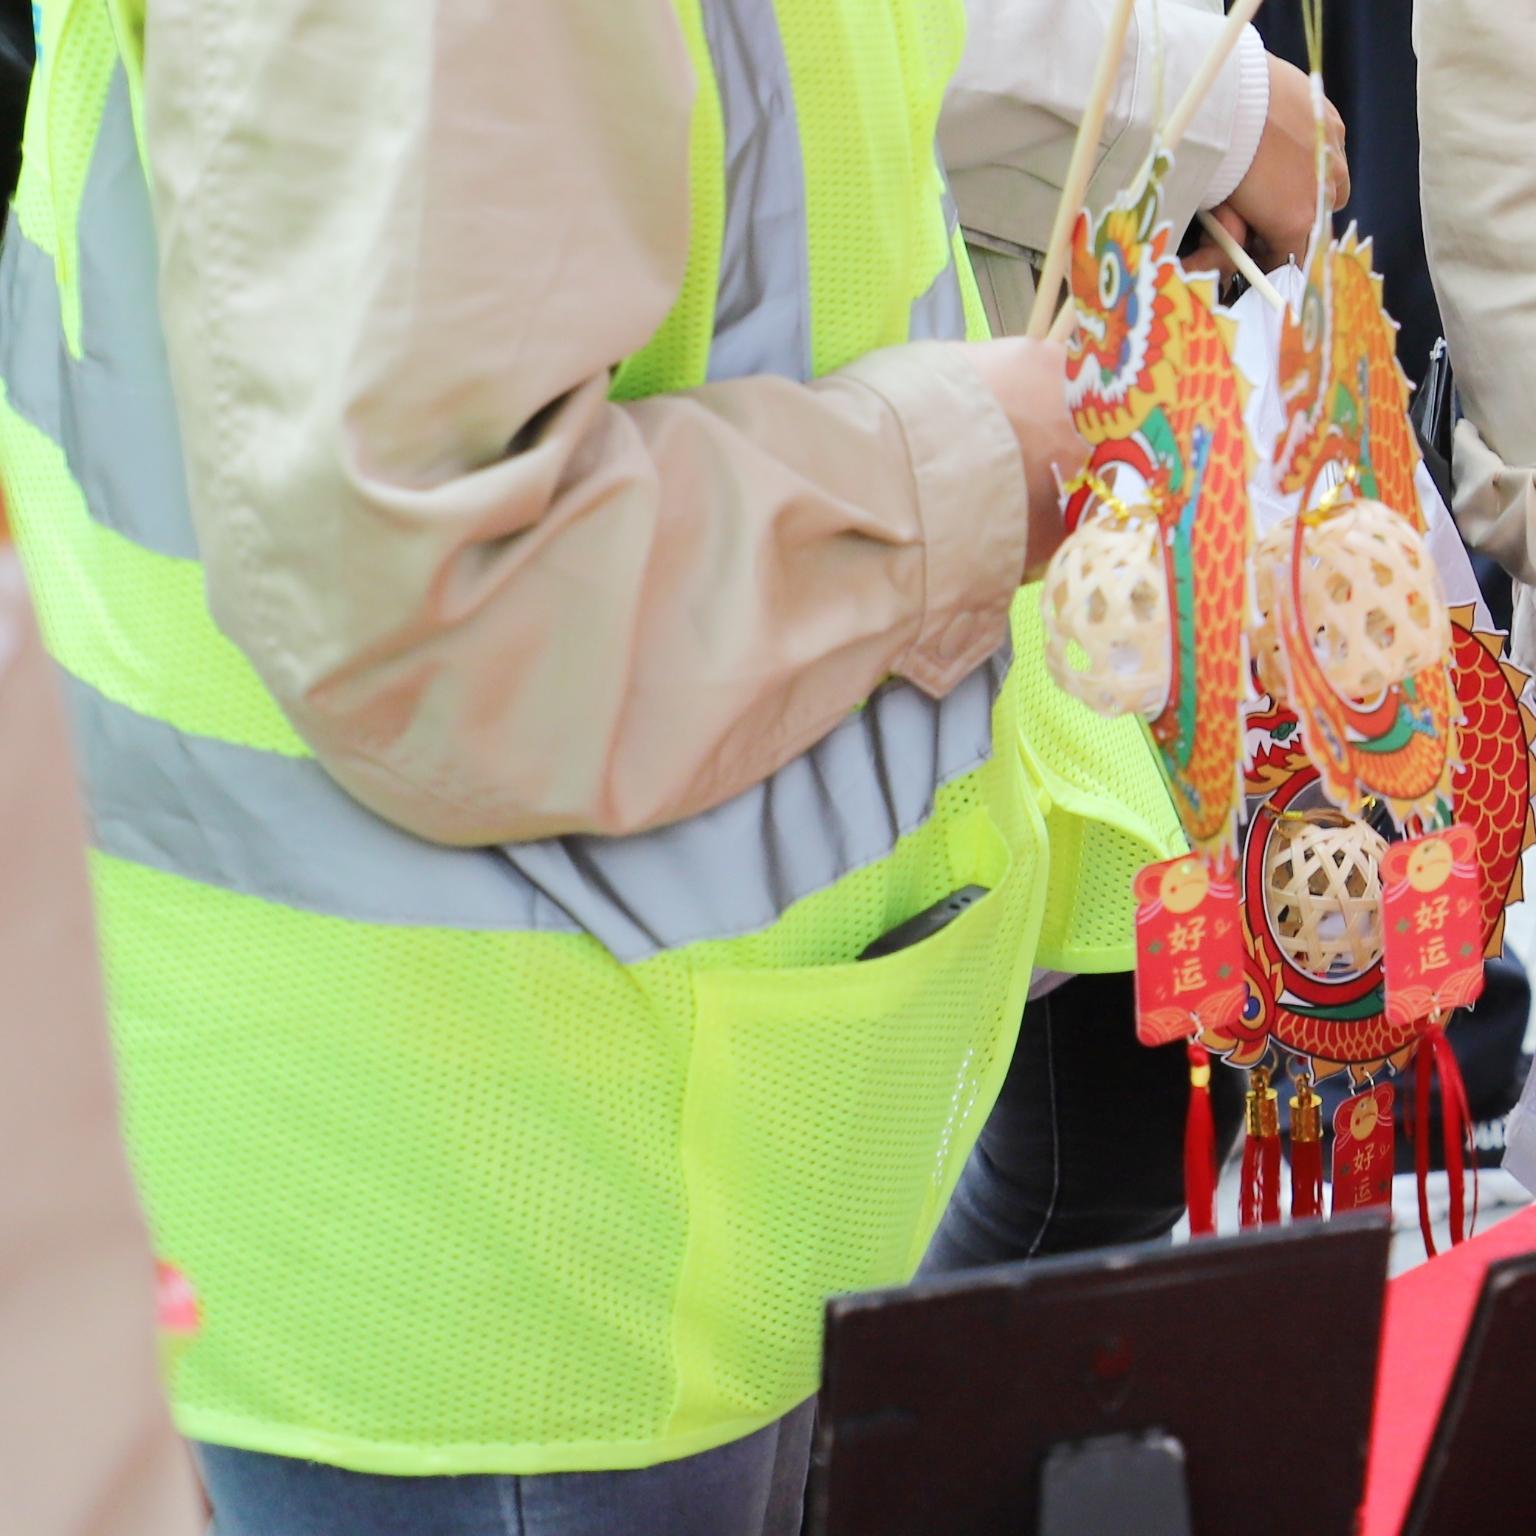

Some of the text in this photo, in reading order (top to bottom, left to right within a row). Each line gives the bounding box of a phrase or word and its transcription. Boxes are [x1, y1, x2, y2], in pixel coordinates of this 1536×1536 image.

[1167, 915, 1207, 996] 好运
[1413, 894, 1450, 975] 好运
[1352, 1142, 1376, 1208] 好运
